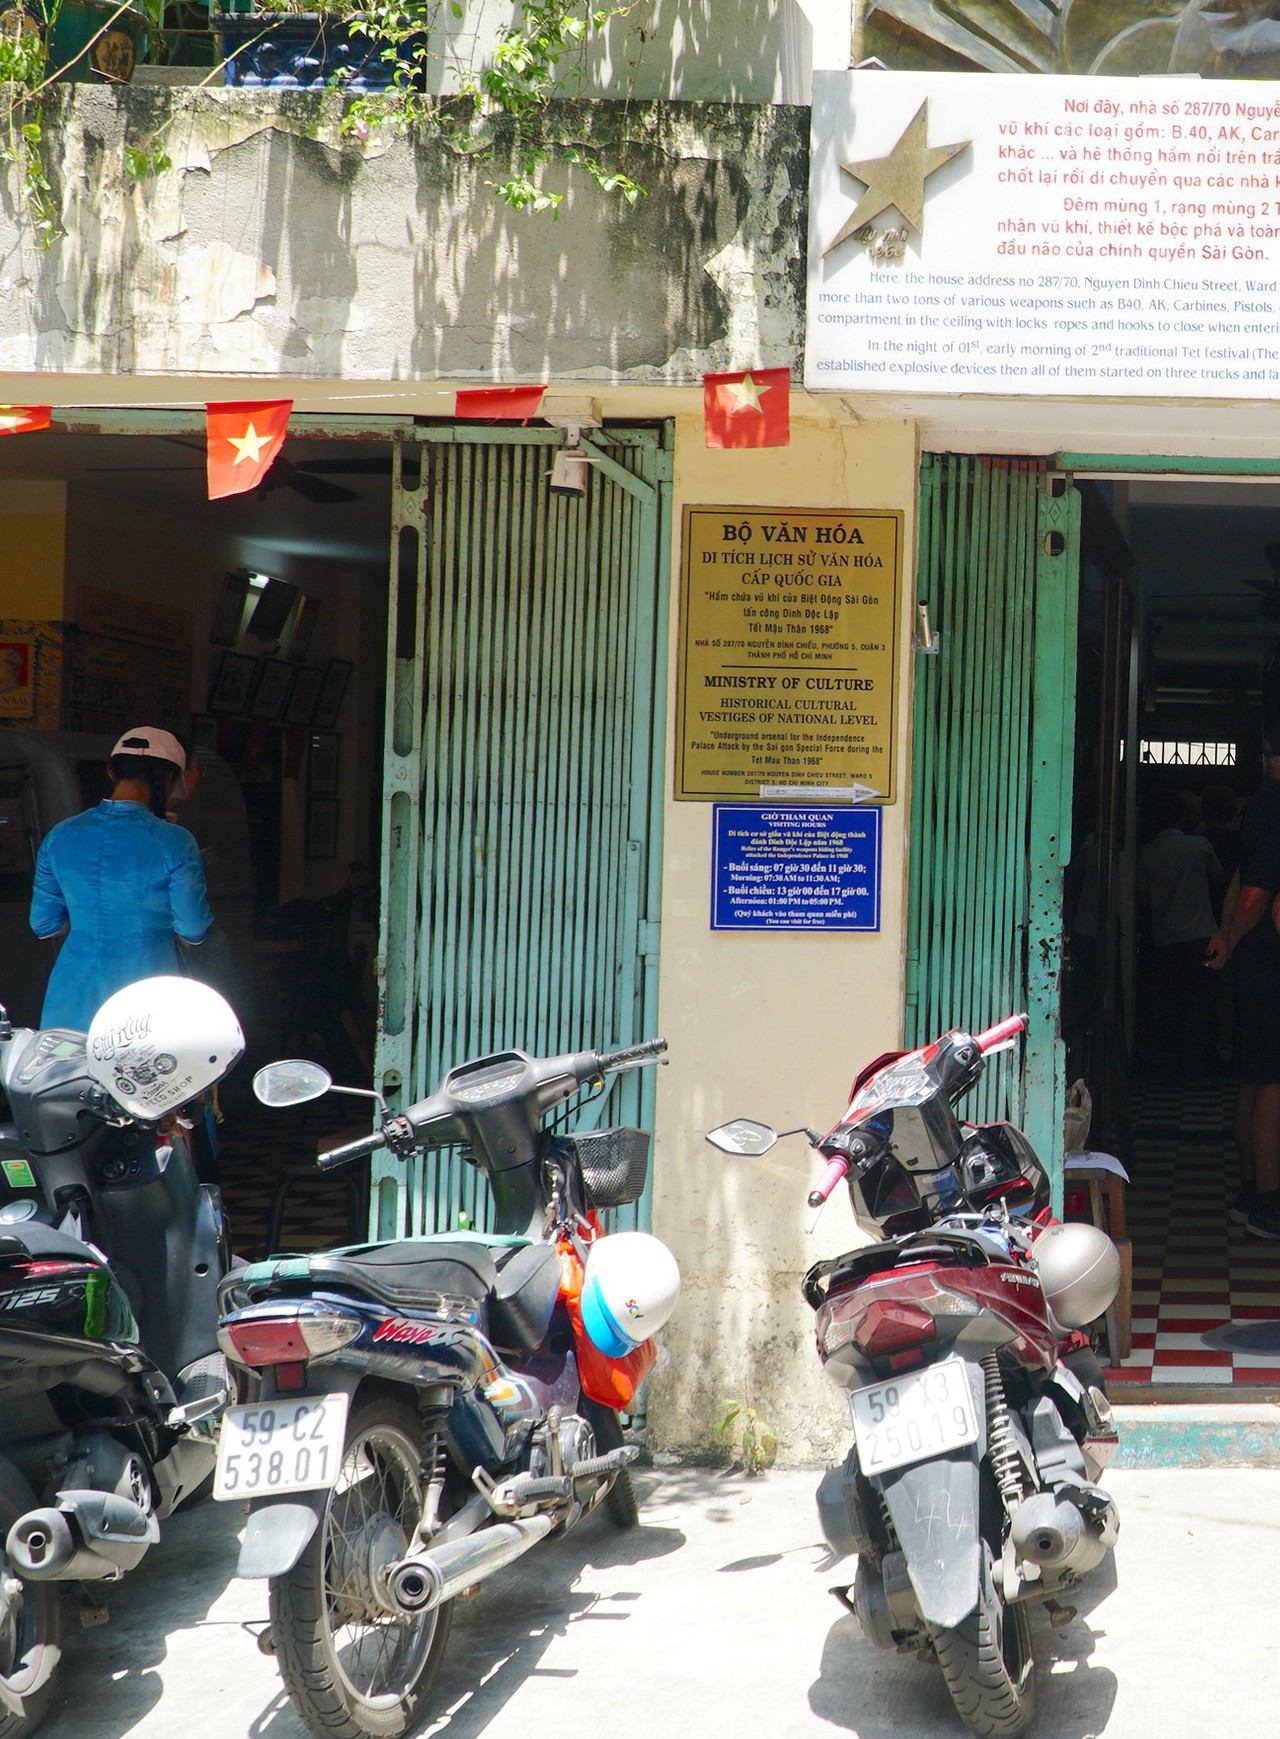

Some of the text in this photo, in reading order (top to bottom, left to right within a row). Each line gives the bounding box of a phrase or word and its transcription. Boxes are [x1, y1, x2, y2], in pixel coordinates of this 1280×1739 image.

[1064, 99, 1089, 113] Nơi
[1093, 99, 1124, 117] đây,
[1129, 100, 1157, 115] nhà
[1162, 100, 1180, 115] số
[1184, 102, 1231, 116] 287/70
[815, 358, 886, 372] established
[888, 360, 948, 375] explosive
[949, 362, 998, 375] devices
[1000, 363, 1028, 375] then
[1030, 364, 1046, 376] all
[1047, 364, 1062, 376] of
[1064, 364, 1097, 377] them
[1099, 365, 1144, 377] started
[1146, 367, 1162, 378] on
[1165, 366, 1198, 378] three
[1200, 367, 1240, 379] trucks
[1242, 368, 1266, 379] and
[722, 520, 865, 546] BỘ VĂN HÓA
[701, 548, 884, 569] DI TÍCH LỊCH SỬ VĂN HÓA
[741, 569, 843, 588] CẤP QUỐC GIA
[704, 675, 874, 692] MINISTRY OF CULTURE
[720, 697, 858, 711] HISTORICAL CULTURAL
[699, 711, 878, 726] VESTIGES OF NATIONAL LEVEL
[808, 814, 834, 822] QUAN
[773, 864, 784, 873] 07
[799, 864, 810, 873] 30
[828, 864, 837, 873] 11
[167, 1075, 193, 1096] SHOP
[5, 1288, 62, 1310] 125
[241, 1404, 326, 1448] 59-C2
[865, 1405, 969, 1467] 250.19
[223, 1445, 329, 1491] 538.01
